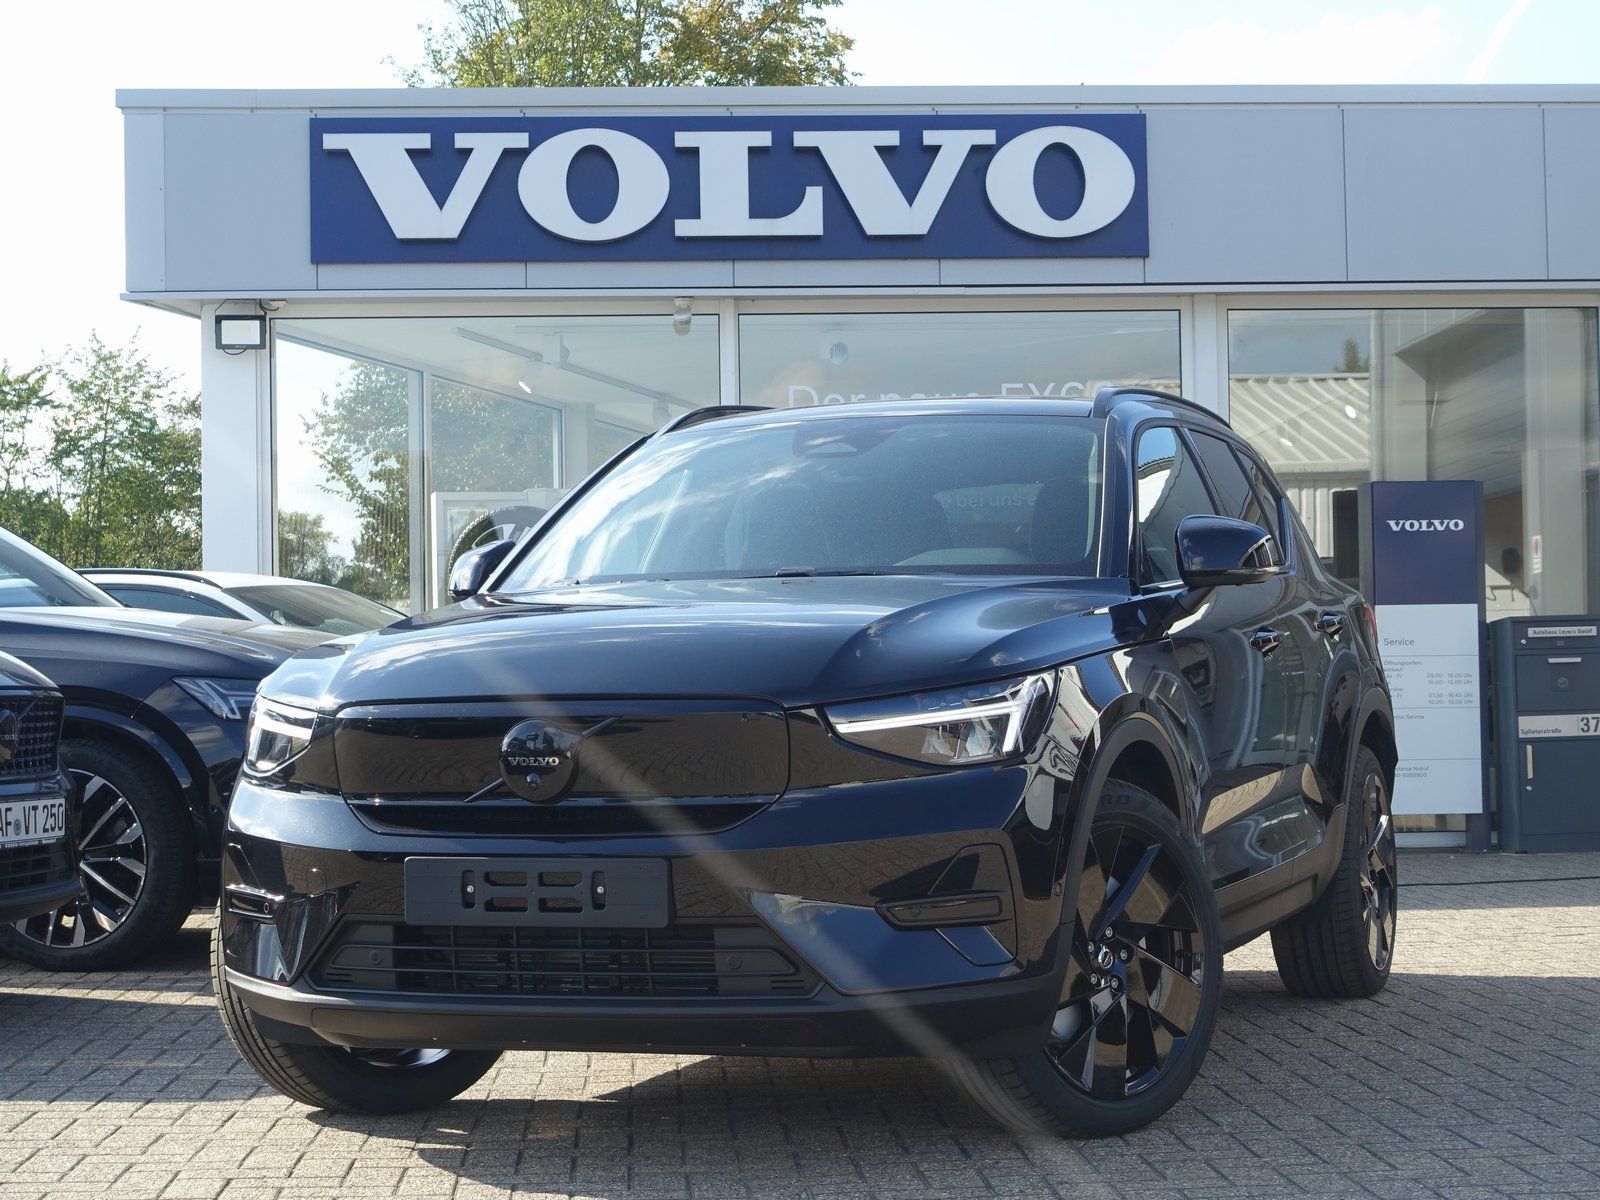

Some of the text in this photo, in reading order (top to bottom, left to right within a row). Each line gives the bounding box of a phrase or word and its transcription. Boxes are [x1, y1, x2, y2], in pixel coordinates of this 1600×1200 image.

[323, 125, 1136, 243] VOLVO
[1386, 519, 1464, 532] VOLVO
[1383, 637, 1415, 646] Service
[1580, 716, 1600, 733] 37
[507, 757, 560, 766] VOLVO
[23, 804, 39, 835] VT
[42, 803, 64, 833] 250
